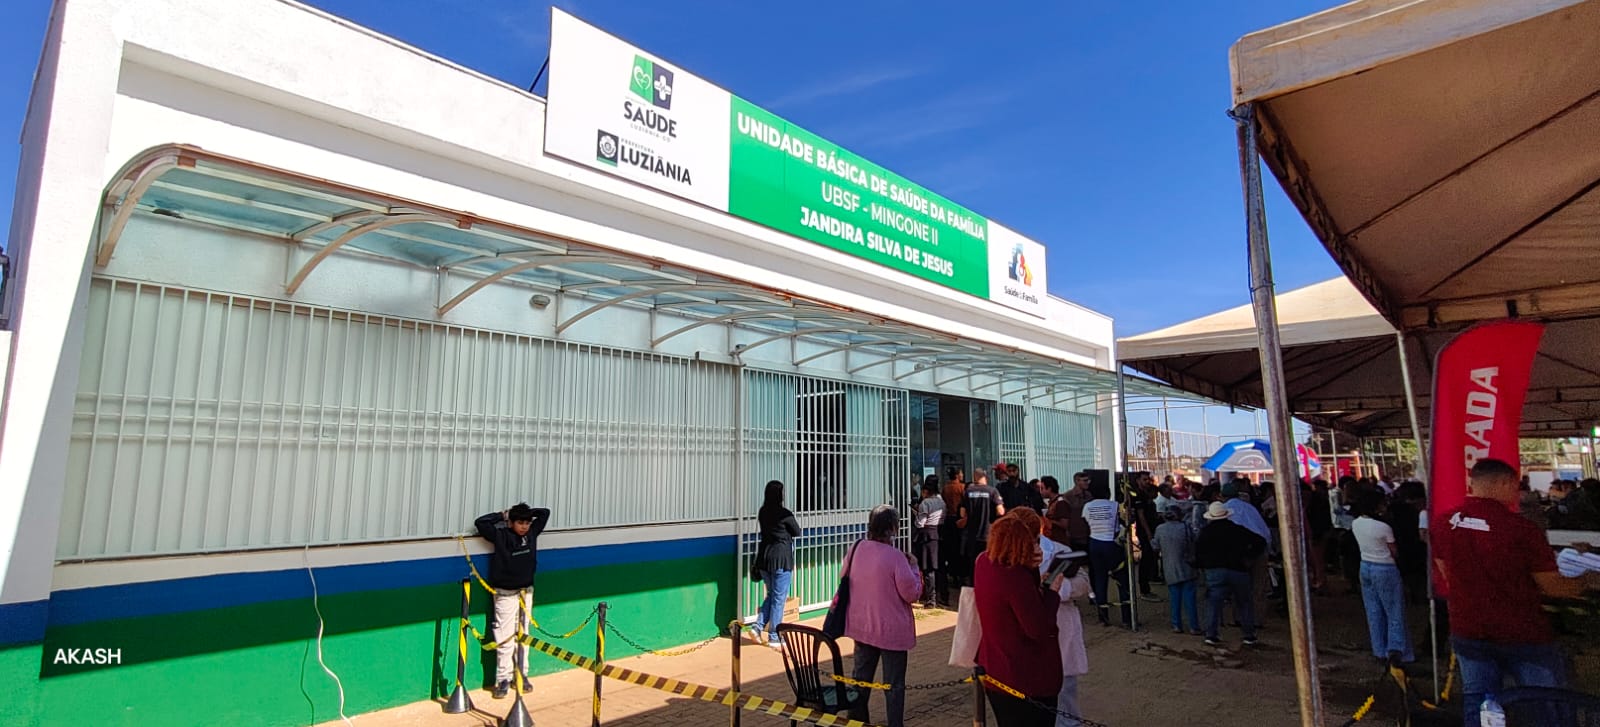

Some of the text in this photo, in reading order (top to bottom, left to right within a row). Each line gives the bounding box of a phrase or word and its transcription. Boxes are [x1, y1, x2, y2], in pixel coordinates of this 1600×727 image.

[624, 101, 677, 138] SAÚDE
[620, 145, 692, 186] LUZIÂNIA
[737, 112, 985, 240] UNIDADE BÁSICA DE SAÚDE DA FAMÍLIA
[800, 207, 954, 277] JANDIRA SILVA DE JESUS
[821, 182, 861, 213] UBSF
[871, 203, 928, 243] MINGONE
[931, 230, 939, 246] II
[1464, 366, 1499, 496] RADA
